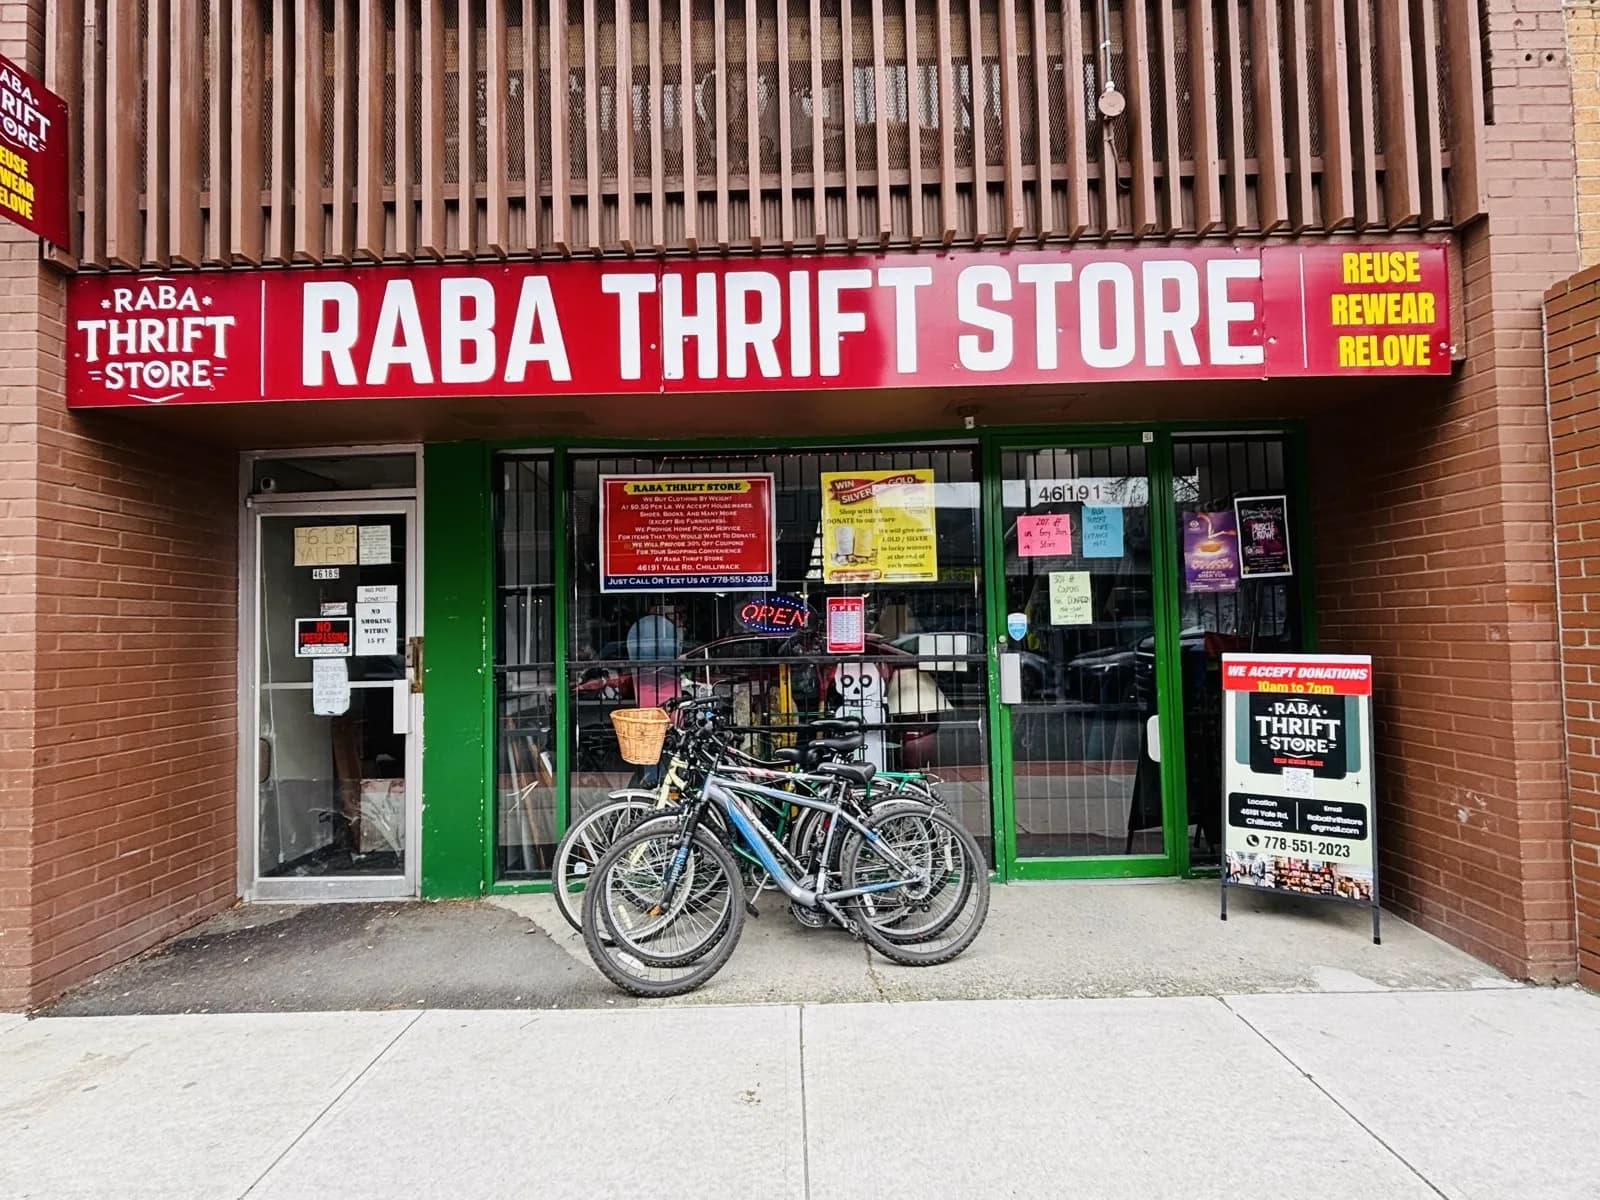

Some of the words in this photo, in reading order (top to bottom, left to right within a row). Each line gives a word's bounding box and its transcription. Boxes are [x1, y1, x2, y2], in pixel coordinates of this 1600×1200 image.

[0, 86, 51, 142] RIFT
[1343, 251, 1421, 283] REUSE
[113, 285, 201, 313] RABA
[1331, 292, 1435, 325] REWEAR
[302, 275, 572, 386] RABA
[601, 266, 932, 380] THRIFT
[957, 259, 1265, 371] STORE
[77, 316, 236, 362] THRIFT
[1339, 334, 1431, 367] RELOVE
[105, 360, 212, 389] STORE
[633, 483, 664, 492] RABA
[667, 483, 704, 492] THRIFT
[706, 482, 741, 491] STORE
[835, 480, 854, 490] WIN
[1039, 484, 1100, 501] 46191
[841, 488, 872, 504] SILVER
[314, 569, 338, 578] 46189
[711, 575, 769, 583] 778-551-2023
[742, 604, 811, 627] OPEN
[316, 621, 331, 632] NO
[1228, 666, 1247, 676] WE
[1248, 666, 1296, 678] ACCEPT
[1298, 667, 1368, 680] DONATIONS
[1257, 681, 1289, 692] 10am
[1291, 682, 1304, 692] to
[1306, 682, 1334, 694] 7pm
[1274, 703, 1321, 717] RABA
[1255, 716, 1341, 741] THRIFT
[1270, 736, 1328, 753] STORE
[1247, 798, 1277, 807] Location
[1260, 810, 1276, 818] Yale
[1246, 818, 1284, 828] Chilliwack
[1311, 824, 1360, 835] @gmail.com
[1264, 836, 1350, 858] 778-551-2023
